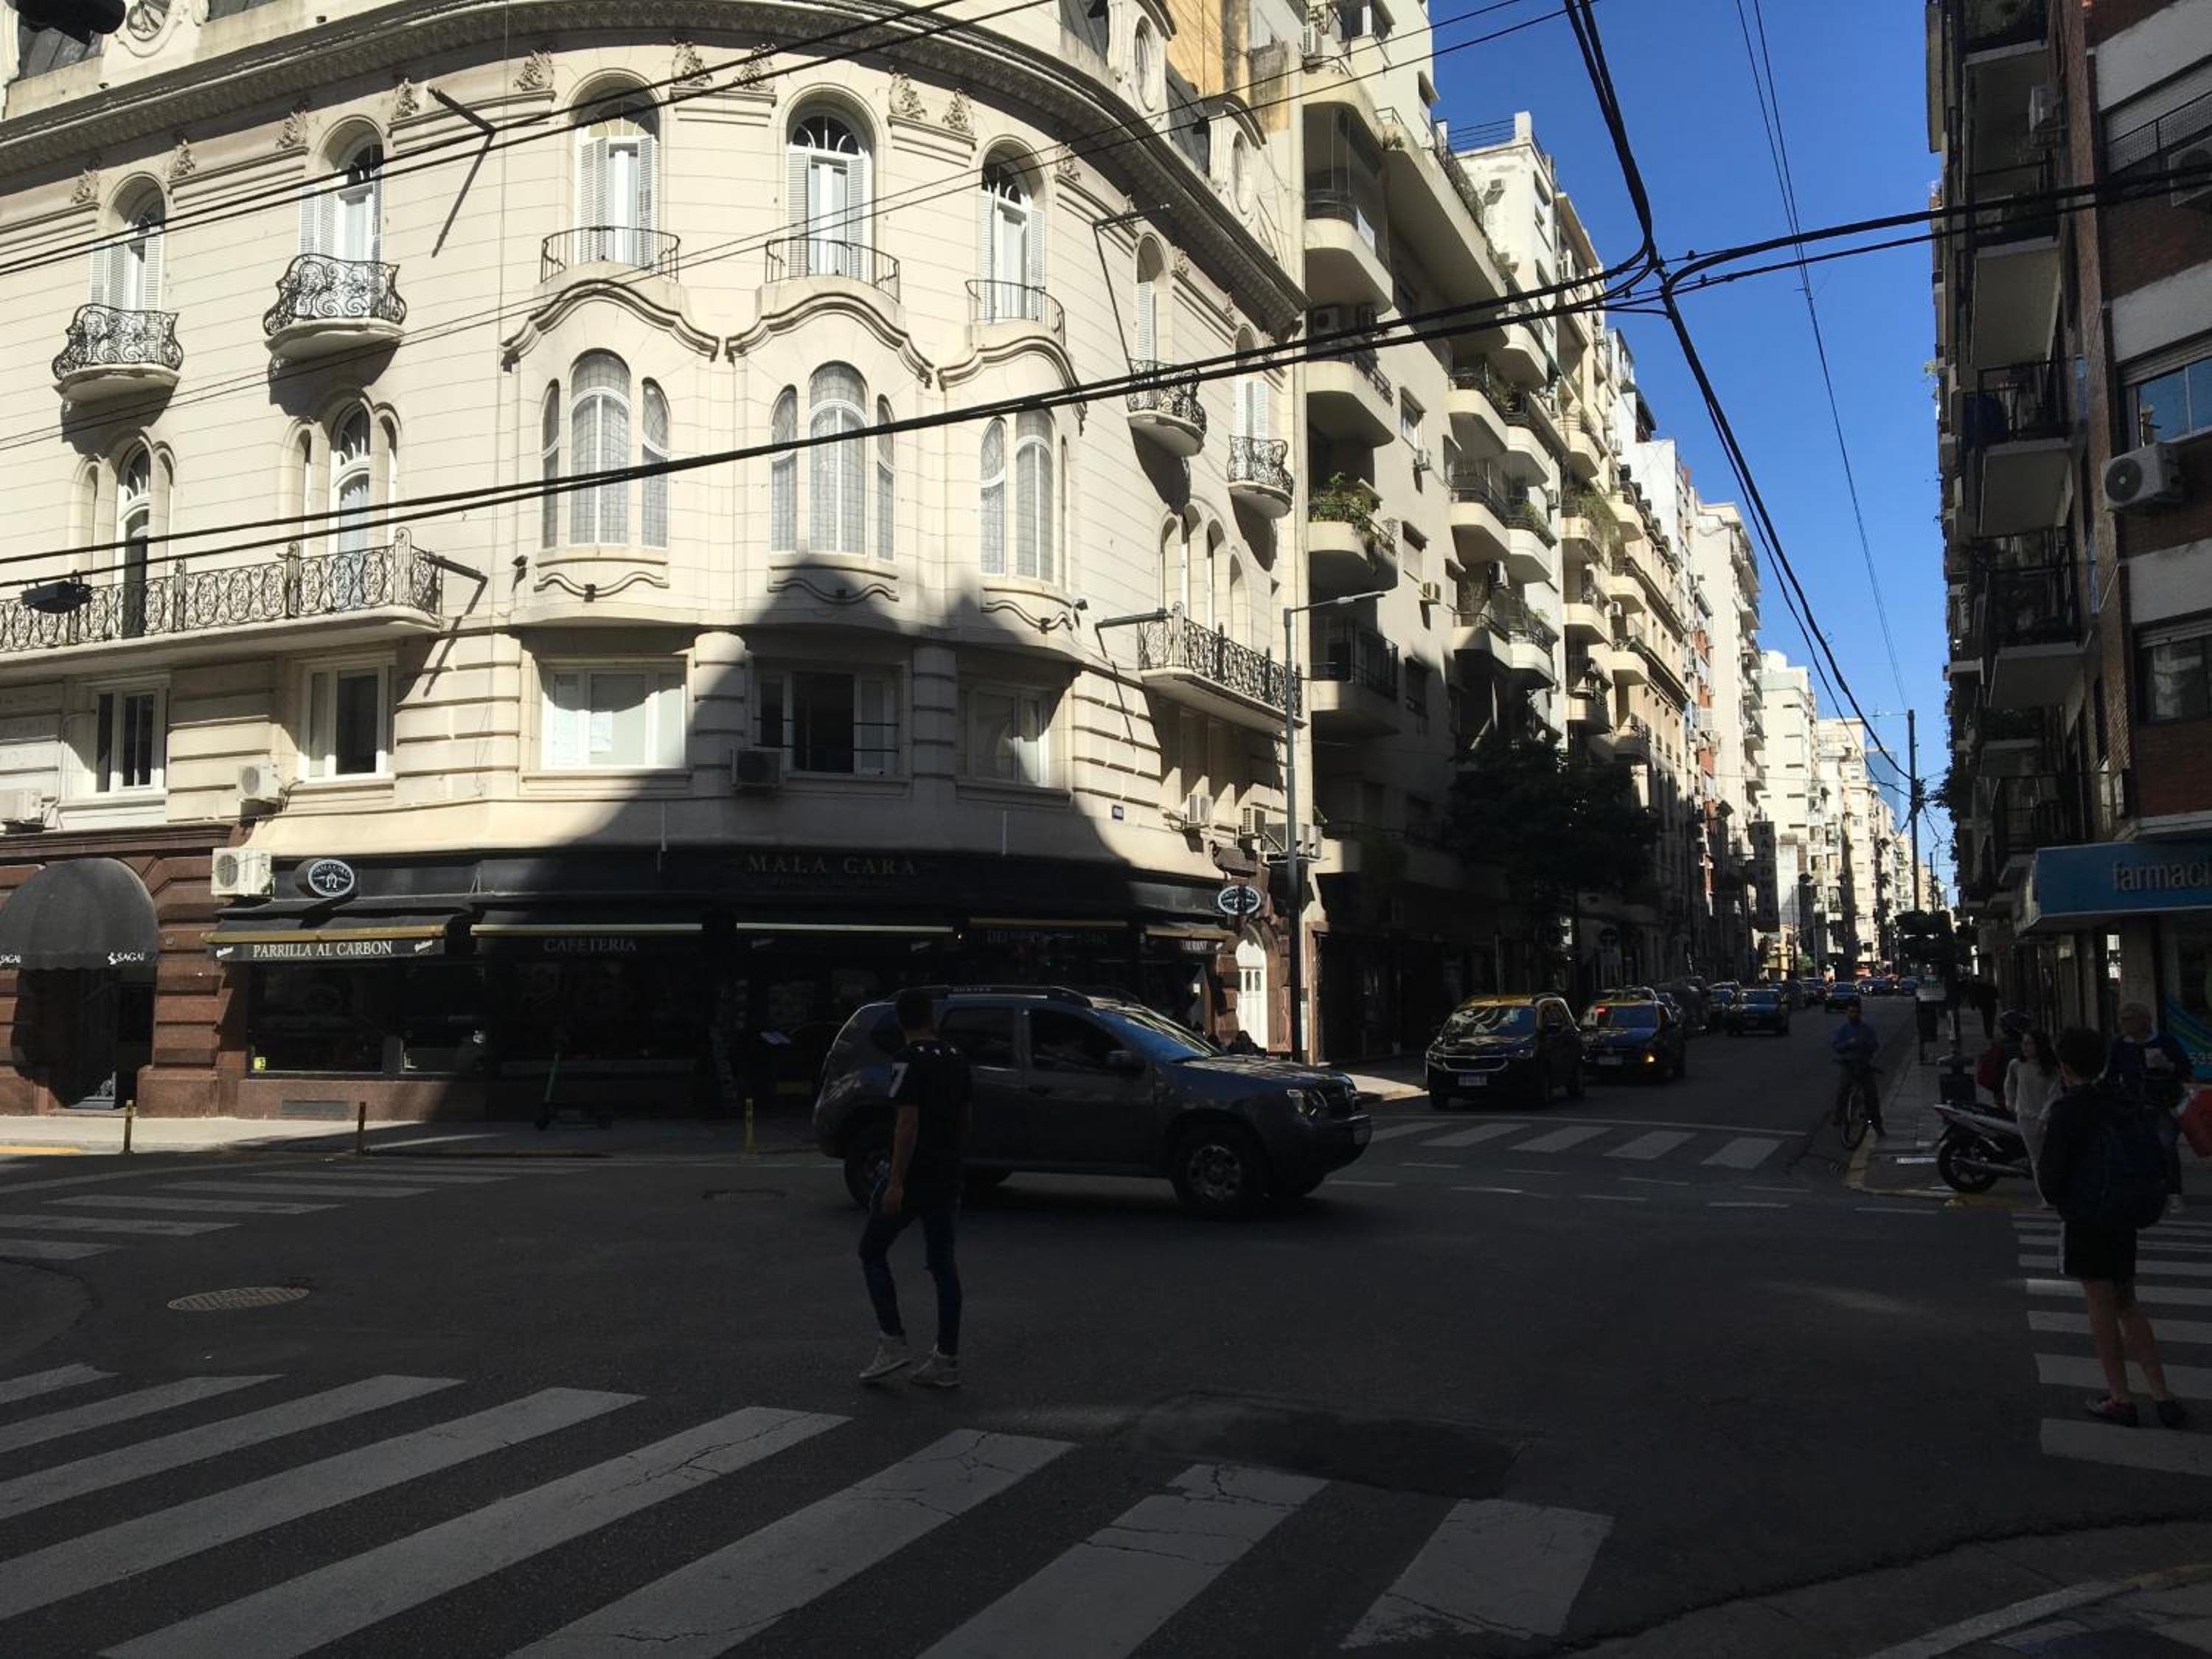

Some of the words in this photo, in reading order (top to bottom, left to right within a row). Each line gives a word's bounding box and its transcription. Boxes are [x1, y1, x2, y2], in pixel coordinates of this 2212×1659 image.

[748, 855, 827, 873] MALA
[843, 857, 917, 875] CARA
[253, 942, 312, 958] PARRILLA
[316, 942, 335, 956] AL
[337, 940, 392, 956] CARBON
[543, 938, 638, 953] CAFETERIA
